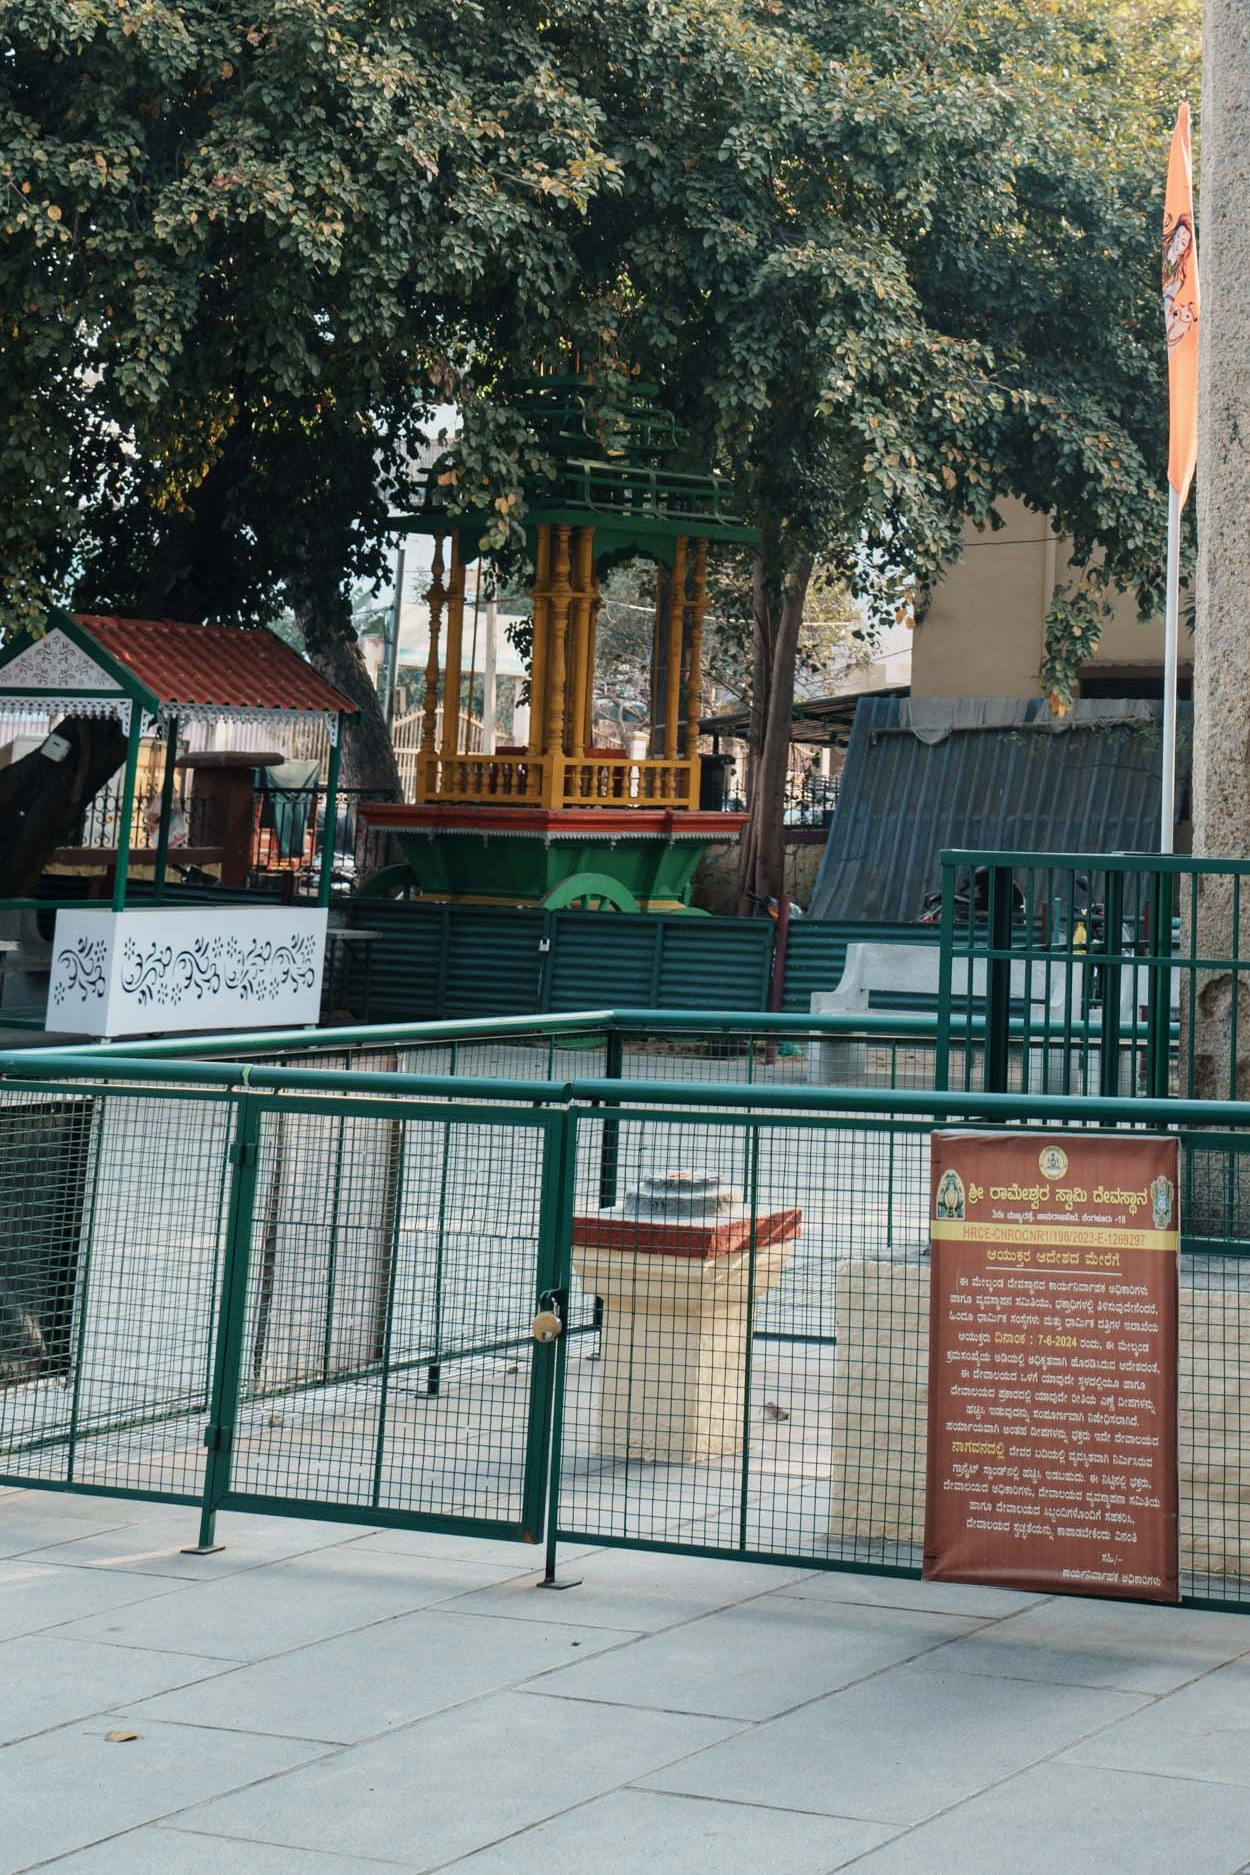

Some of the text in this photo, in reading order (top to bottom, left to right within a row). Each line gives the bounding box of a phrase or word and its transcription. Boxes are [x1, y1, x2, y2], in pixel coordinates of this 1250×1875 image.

[968, 1182, 1148, 1215] ಶ್ರೀ ರಾಮೇಶ್ವರ ಸ್ವಾಮಿ ದೇವಸ್ಥಾನ
[986, 1249, 1120, 1268] ಆಯುಕ್ತರ ಆದೇಶದ ಮೇರೆಗೆ
[959, 1276, 969, 1287] ಈ
[949, 1294, 973, 1304] ಹಾಗೂ
[948, 1310, 974, 1322] ಹಿಂದೂ
[976, 1312, 1008, 1324] ಧಾರ್ಮಿಕ
[1043, 1316, 1063, 1331] ಮತ್ತು
[1064, 1317, 1095, 1329] ಧಾರ್ಮಿಕ
[958, 1332, 992, 1347] ಆಯುಕ್ತರು
[994, 1331, 1026, 1345] ದಿನಾಂಕ
[1105, 1340, 1115, 1350] ಈ
[960, 1368, 970, 1379] ಈ
[972, 1367, 1018, 1382] ದೇವಾಲಯದ
[1020, 1371, 1039, 1383] ಒಳಗೆ
[1041, 1373, 1075, 1387] ಯಾವುದೇ
[1122, 1380, 1146, 1391] ಹಾಗೂ
[950, 1384, 996, 1398] ದೇವಾಲಯದ
[1034, 1391, 1068, 1404] ಯಾವುದೇ
[1114, 1431, 1160, 1447] ದೇವಾಲಯದ
[1089, 1474, 1099, 1484] ಈ
[943, 1478, 989, 1494] ದೇವಾಲಯದ
[1038, 1486, 1083, 1501] ದೇವಾಲಯದ
[969, 1500, 993, 1512] ಹಾಗೂ
[995, 1500, 1041, 1516] ದೇವಾಲಯದ
[966, 1516, 1011, 1532] ದೇವಾಲಯದ
